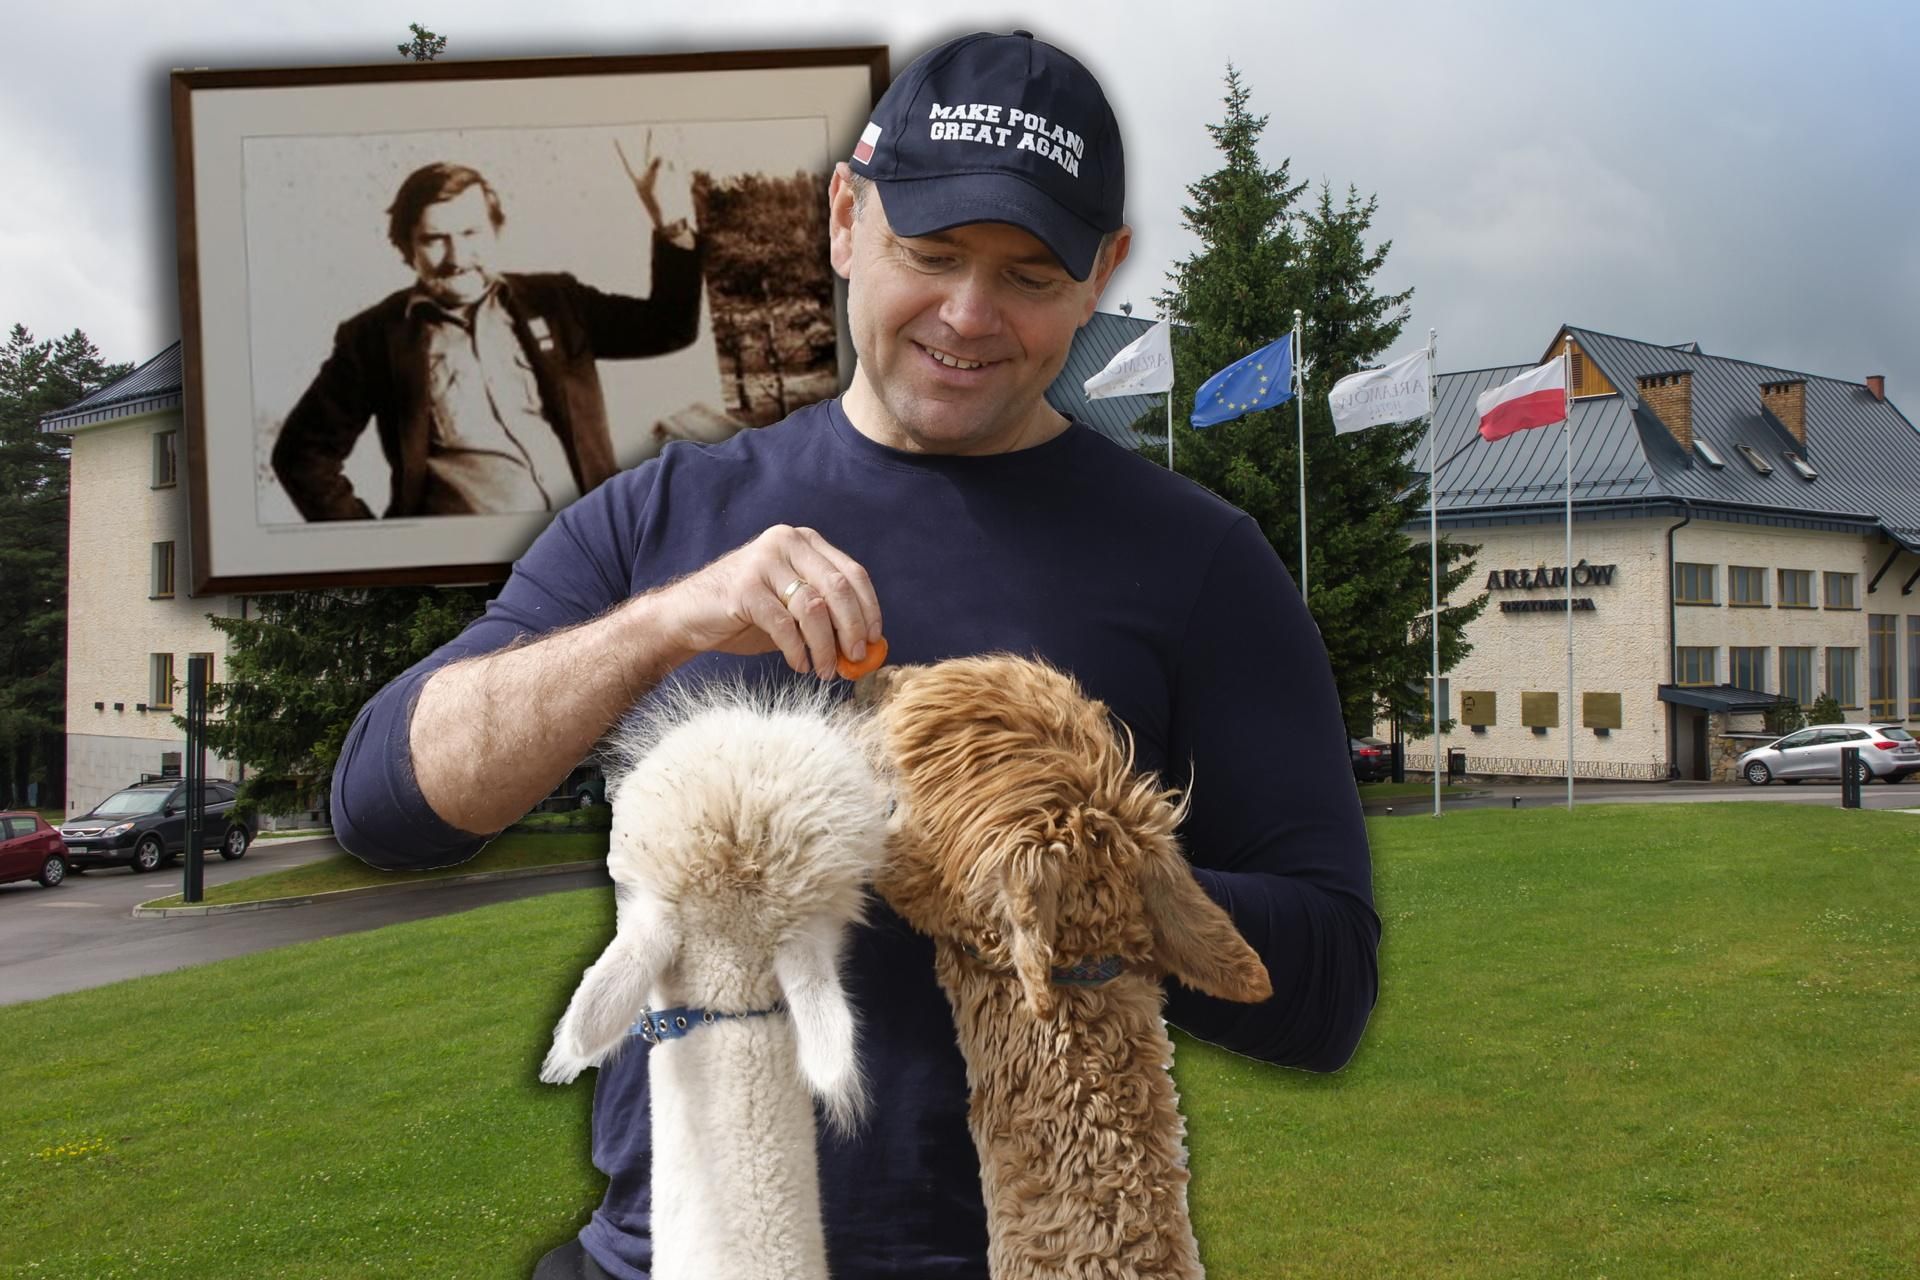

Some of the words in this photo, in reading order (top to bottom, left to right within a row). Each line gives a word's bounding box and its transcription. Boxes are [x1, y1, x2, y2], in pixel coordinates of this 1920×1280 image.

[929, 103, 1002, 124] MAKE
[1008, 108, 1085, 160] POLAND
[930, 121, 1012, 147] GREAT
[1017, 132, 1080, 179] AGAIN
[1485, 558, 1617, 591] ARŁAMÓW
